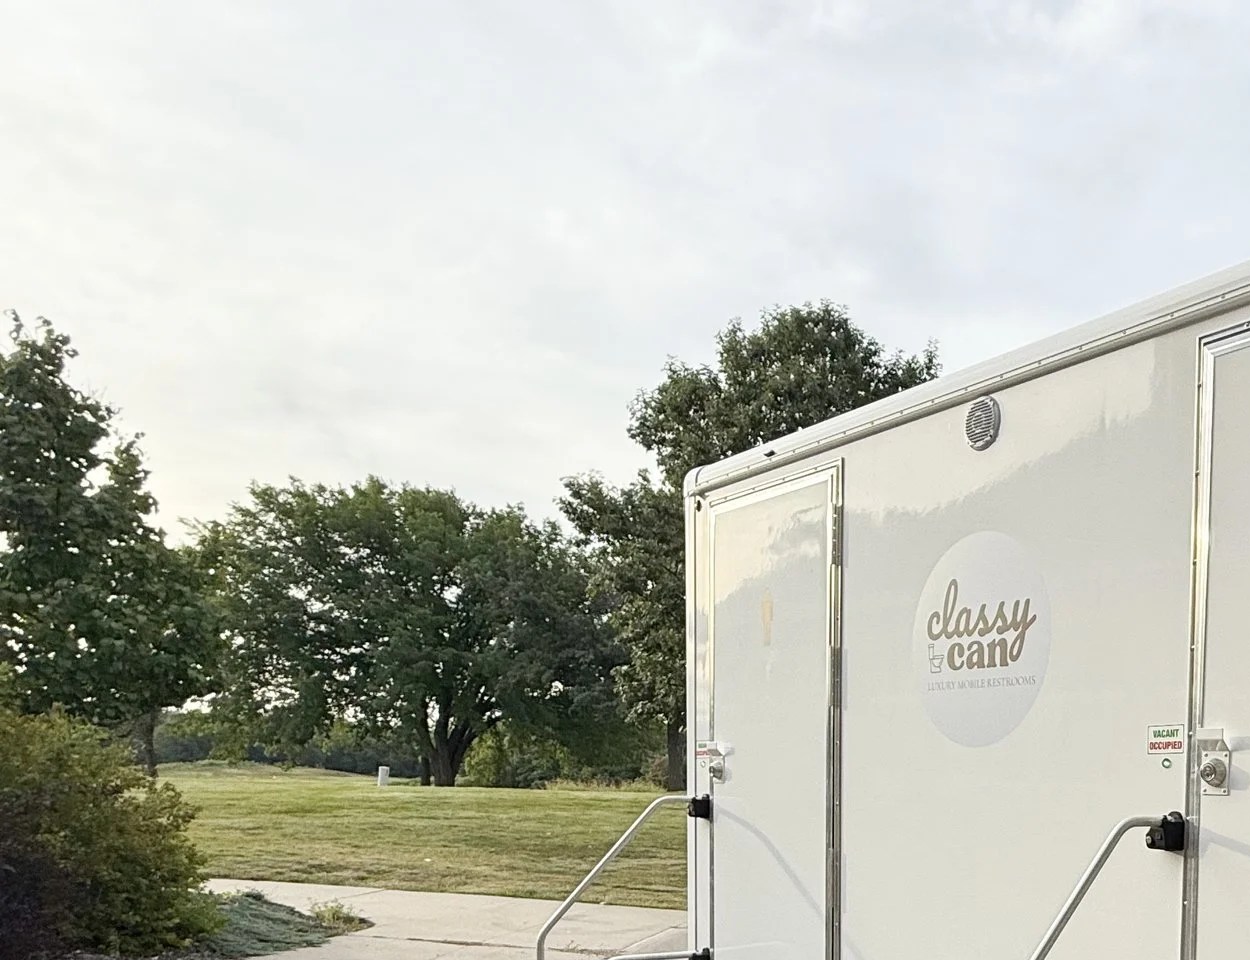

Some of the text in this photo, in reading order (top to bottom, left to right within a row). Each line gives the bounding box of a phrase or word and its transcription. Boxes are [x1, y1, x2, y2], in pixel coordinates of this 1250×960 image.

[927, 578, 1037, 662] classy
[947, 638, 1009, 671] can
[928, 675, 1036, 691] LUXURY MOBILE RESTROOMS
[1152, 728, 1180, 739] VACANT
[1149, 740, 1183, 751] OCCUPIED
